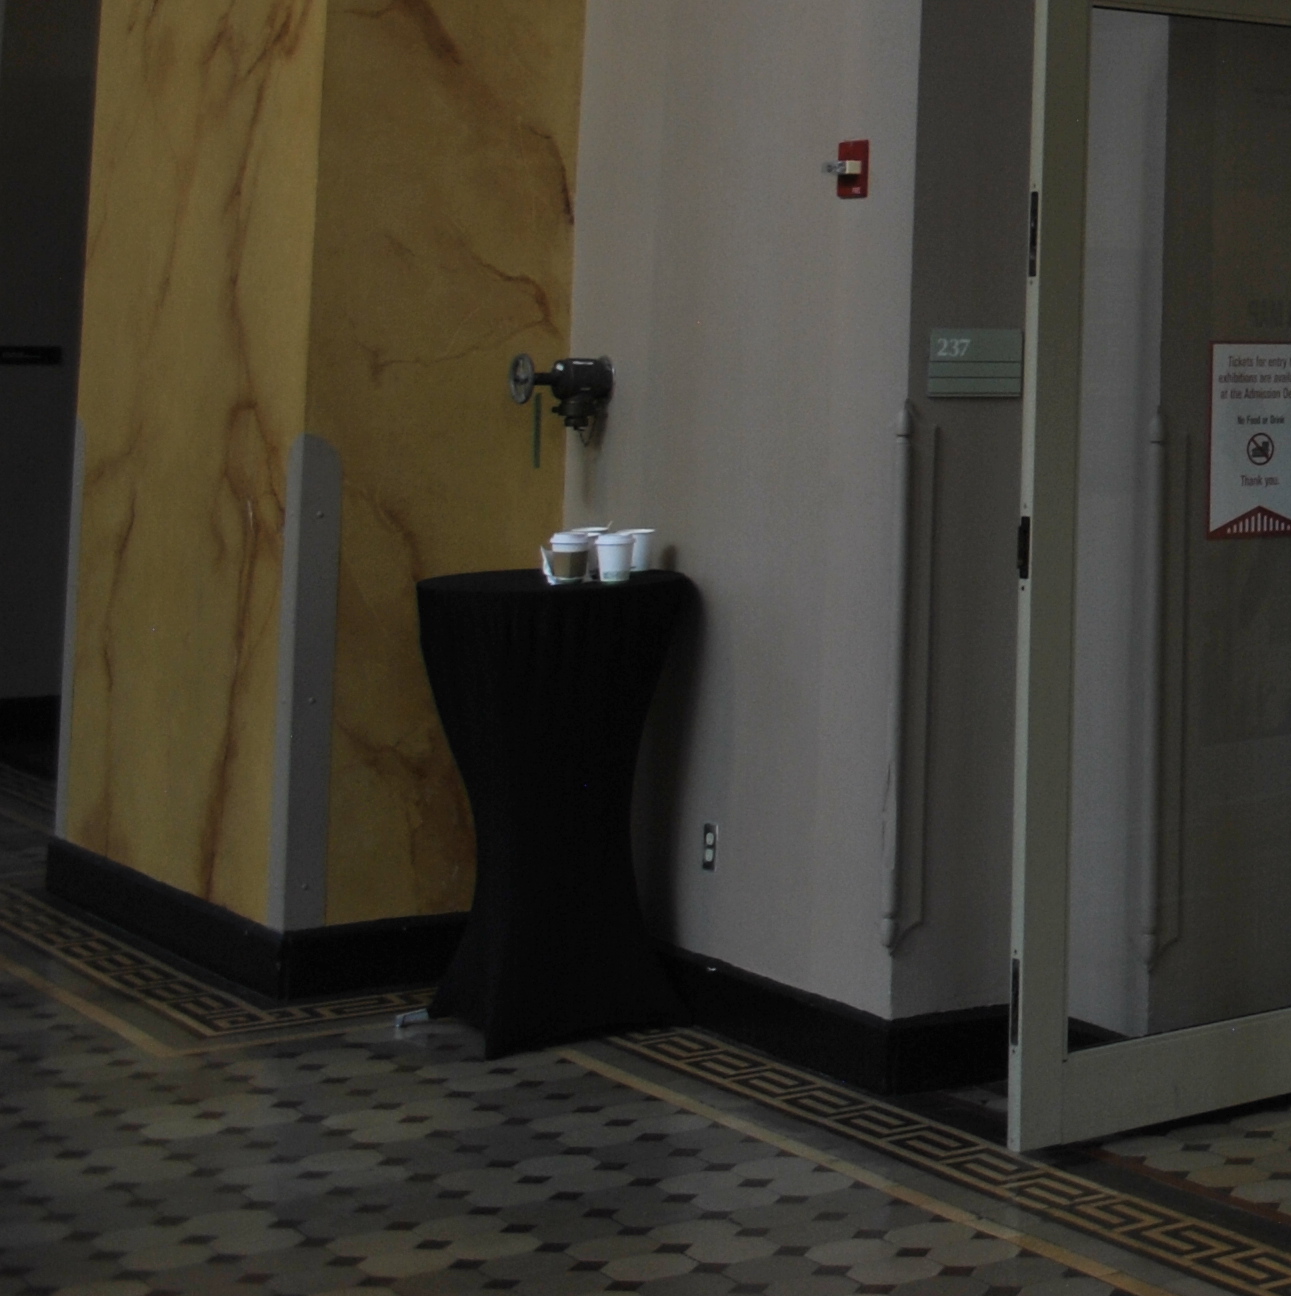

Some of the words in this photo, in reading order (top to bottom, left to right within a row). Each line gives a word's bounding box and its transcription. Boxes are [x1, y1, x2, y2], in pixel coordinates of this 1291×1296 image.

[937, 338, 971, 357] 237
[1228, 355, 1253, 368] Tickets
[1256, 355, 1267, 367] for
[1268, 357, 1287, 369] entry
[1218, 372, 1257, 384] exhibitions
[1259, 374, 1272, 384] are
[1230, 388, 1242, 400] the
[1244, 388, 1281, 400] Admission
[1240, 475, 1262, 486] Thank
